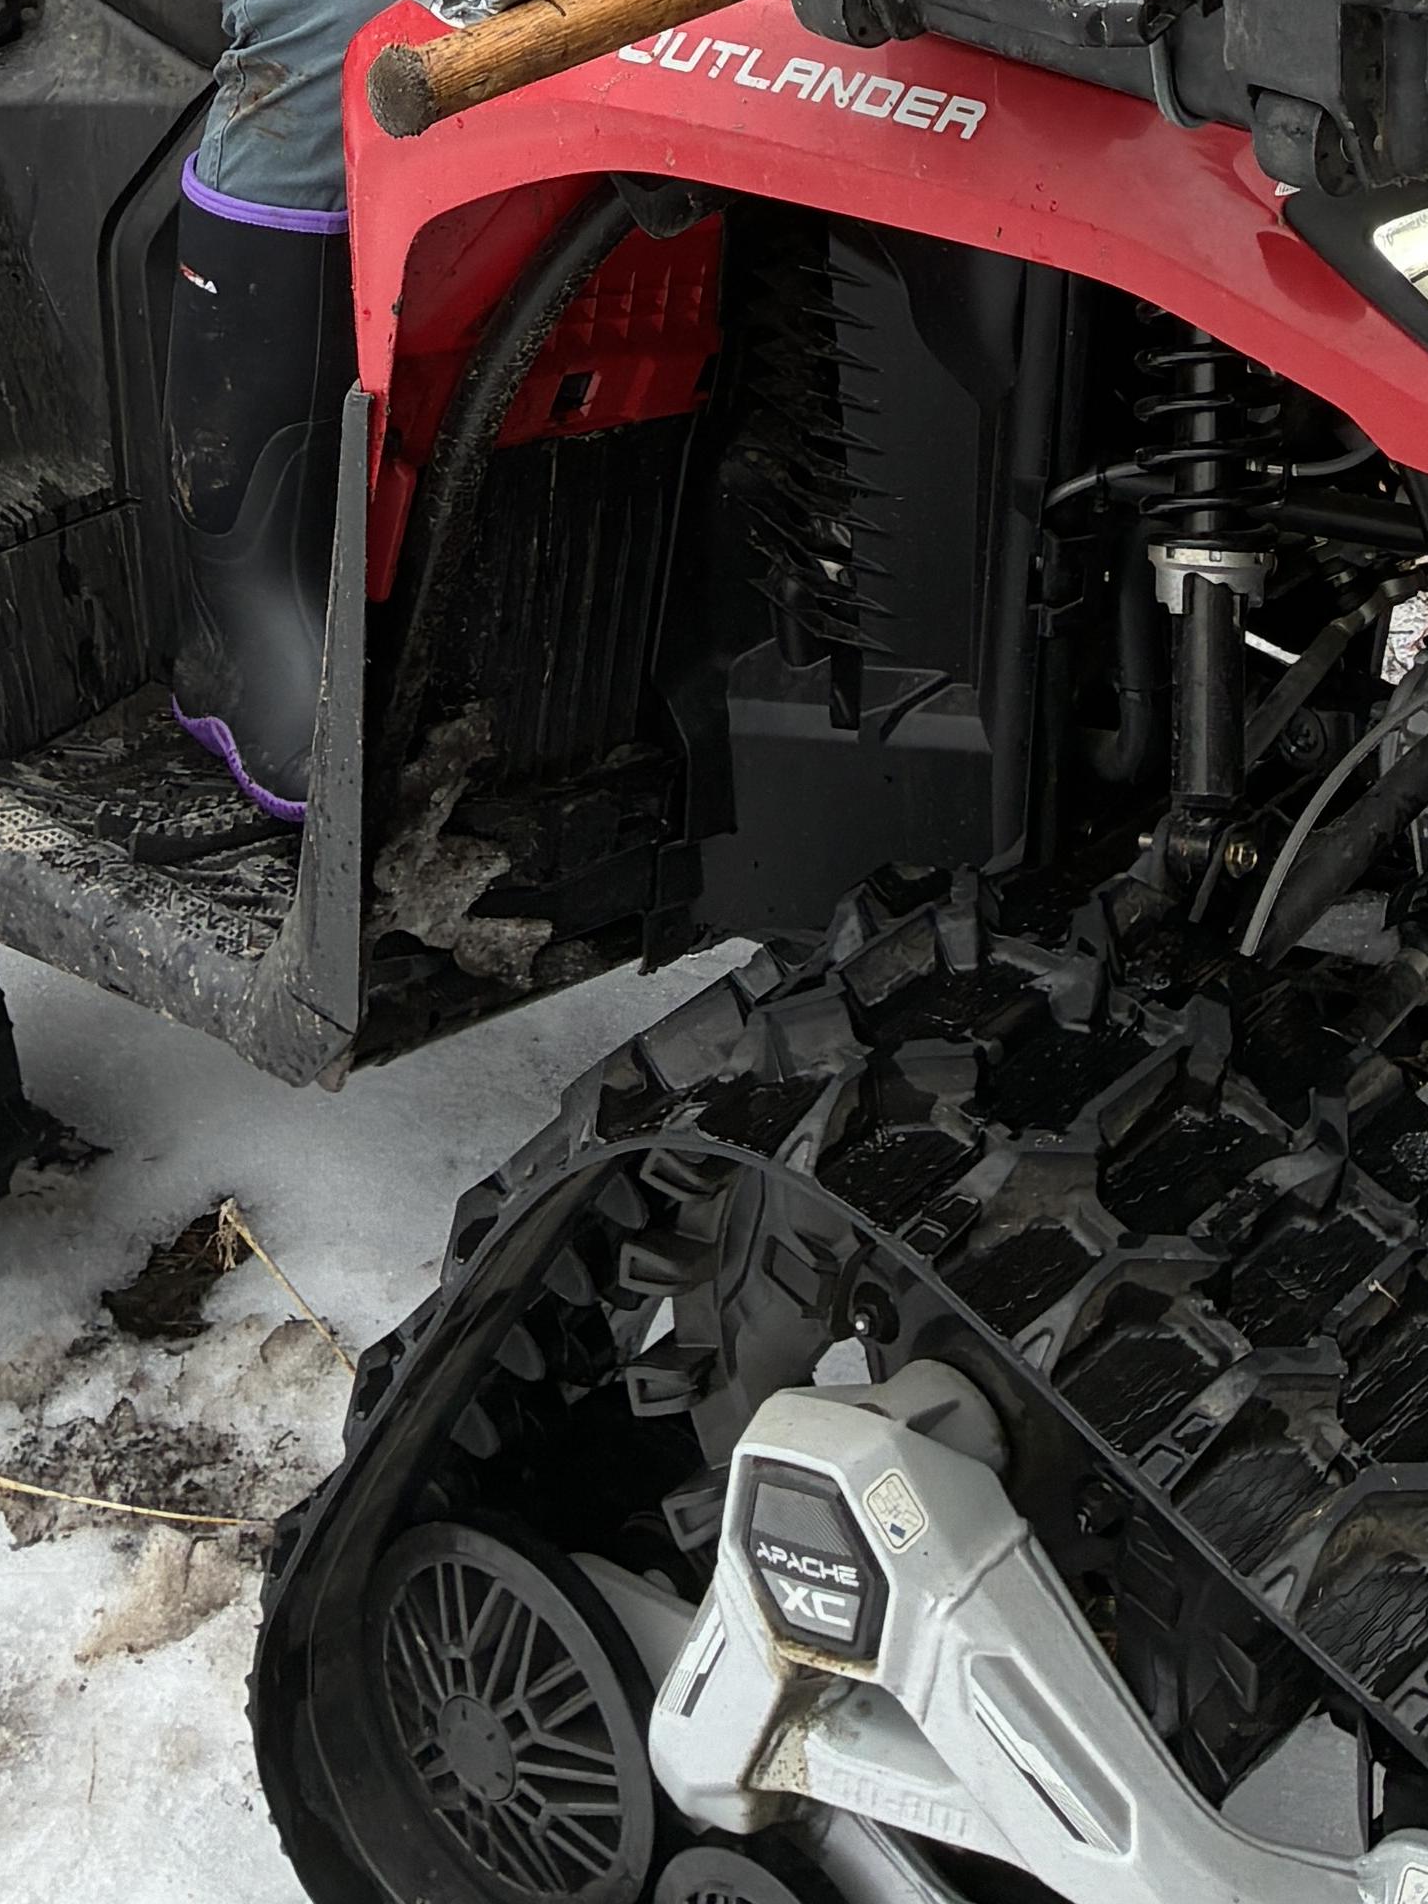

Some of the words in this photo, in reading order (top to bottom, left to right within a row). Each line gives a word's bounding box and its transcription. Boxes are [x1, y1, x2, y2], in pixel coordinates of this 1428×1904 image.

[618, 28, 986, 140] OUTLANDER
[756, 1542, 860, 1588] APACHE
[778, 1579, 852, 1628] XC
